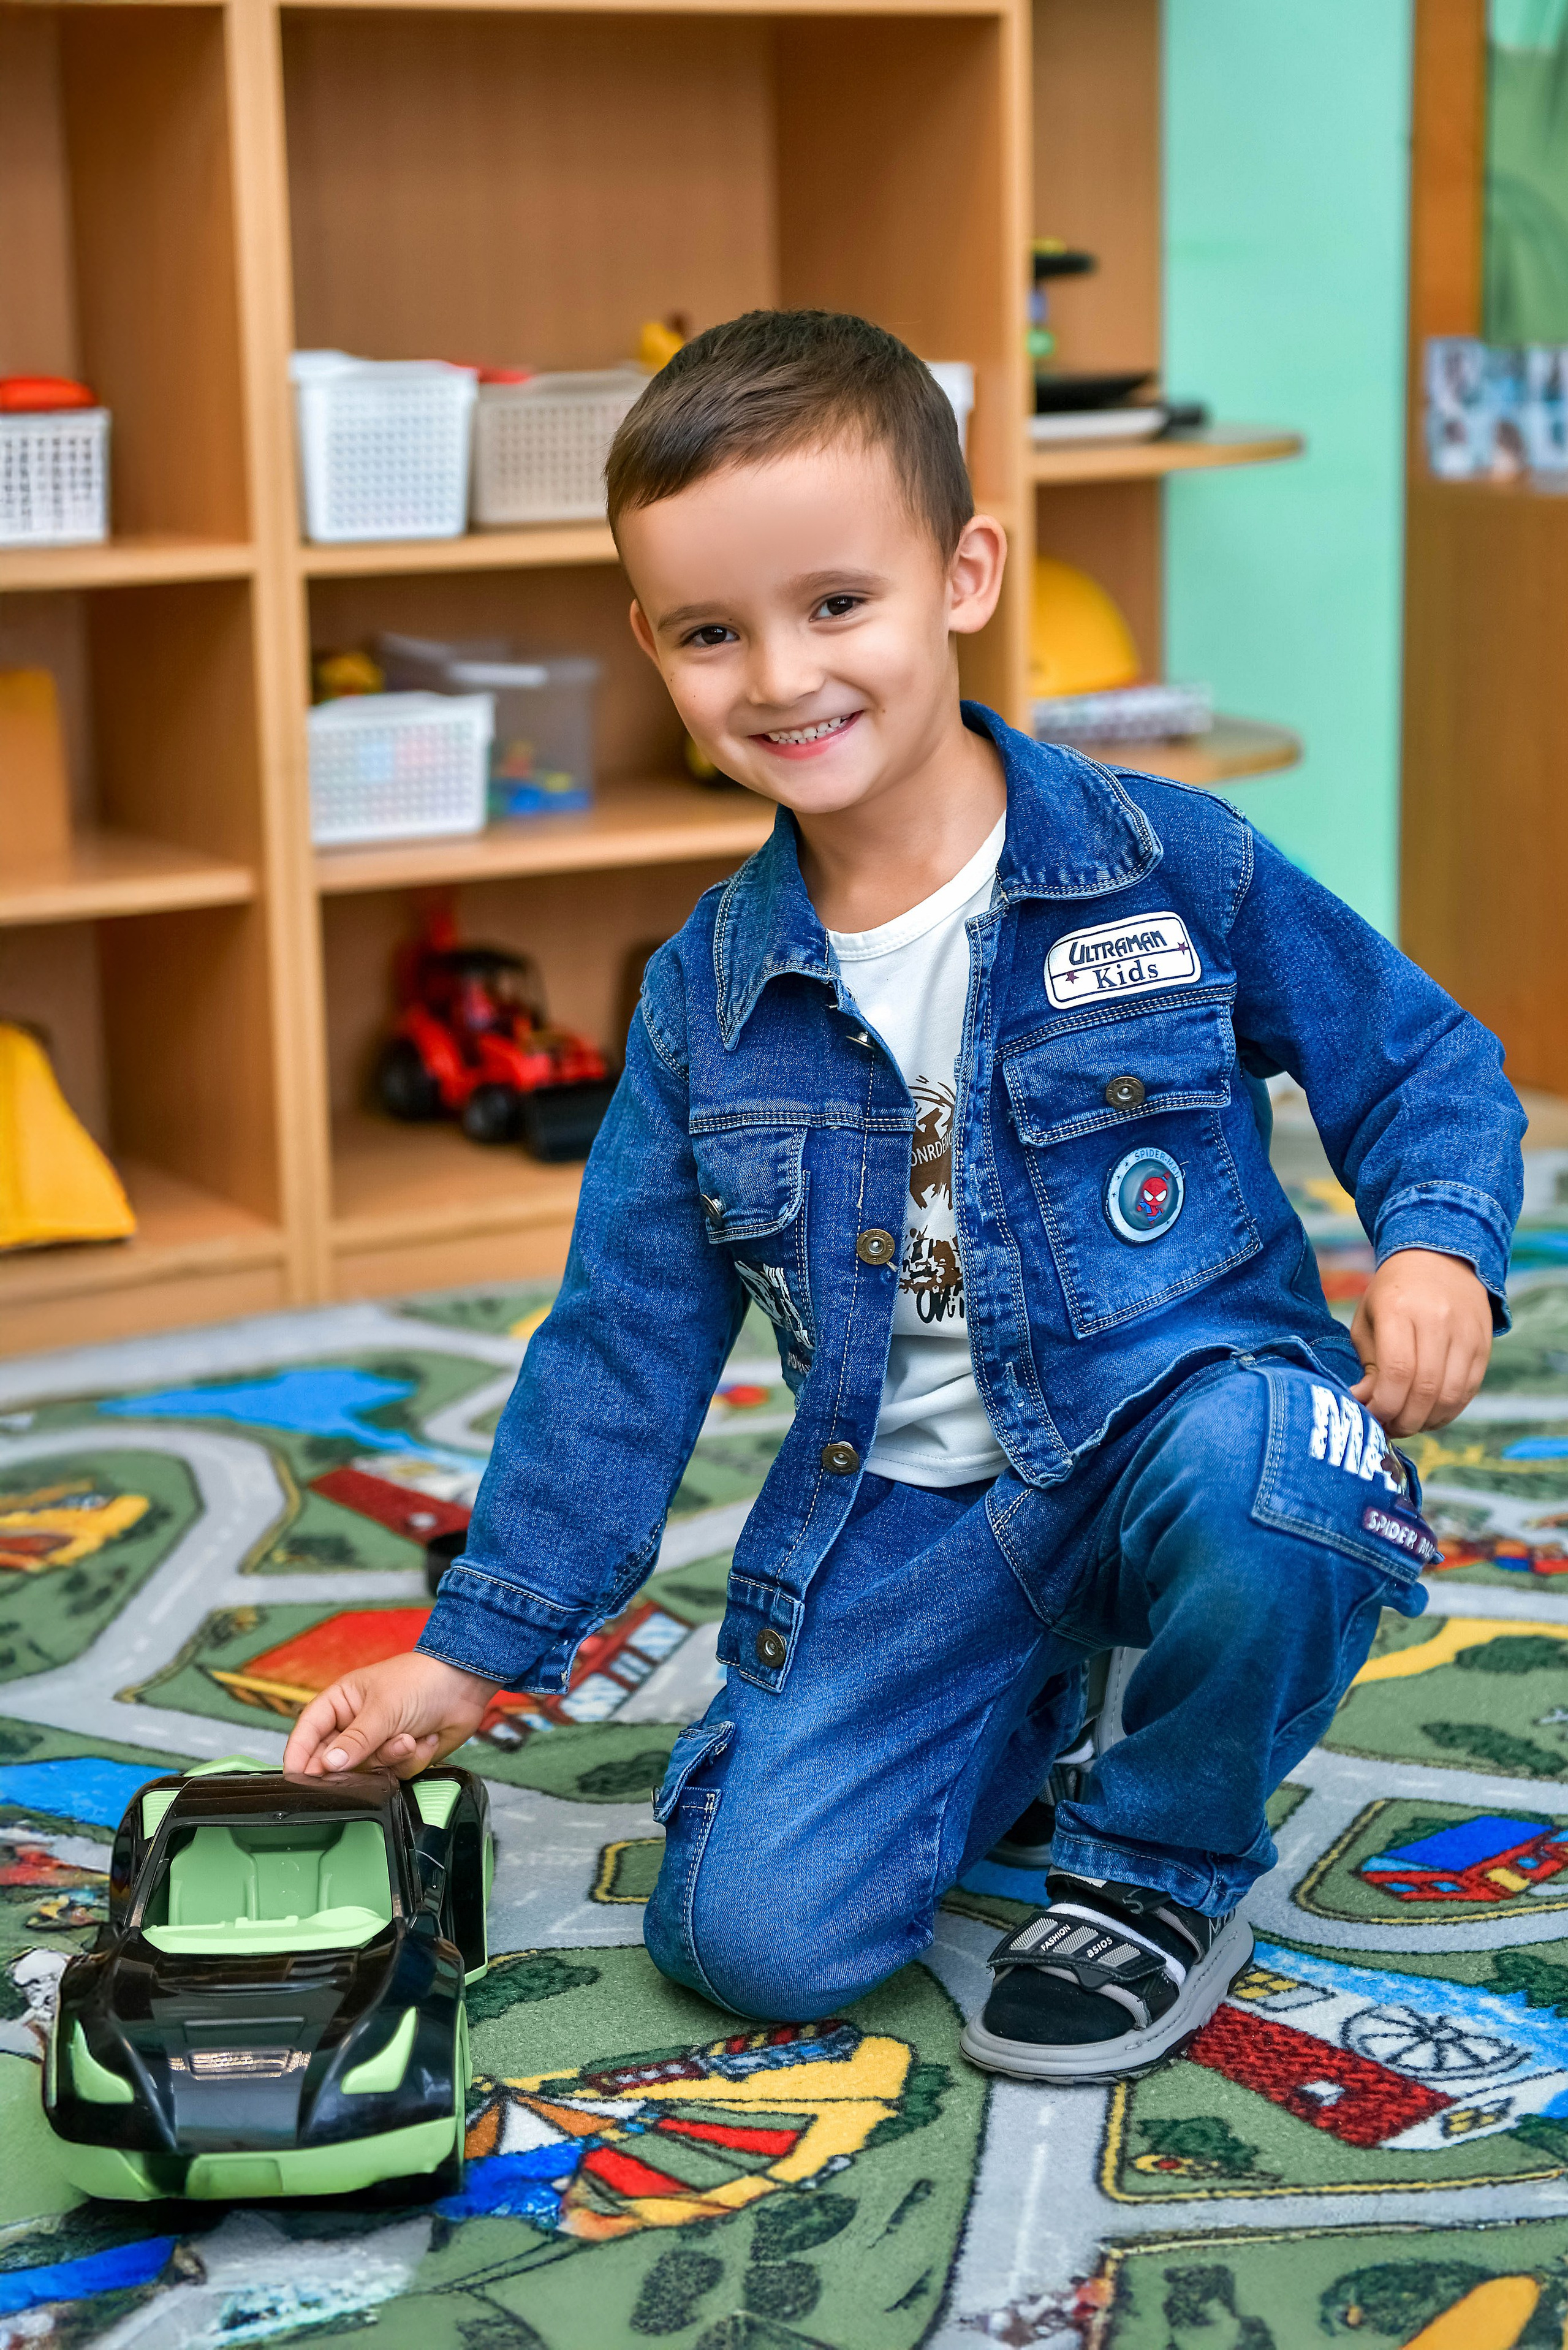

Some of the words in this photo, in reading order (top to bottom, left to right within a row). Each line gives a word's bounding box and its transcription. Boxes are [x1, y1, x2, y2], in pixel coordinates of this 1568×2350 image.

[1069, 930, 1167, 966] ULTRAMAN
[1093, 959, 1159, 990] Kids
[1368, 1510, 1418, 1550] SPIDER
[1040, 1924, 1072, 1952] FASHION
